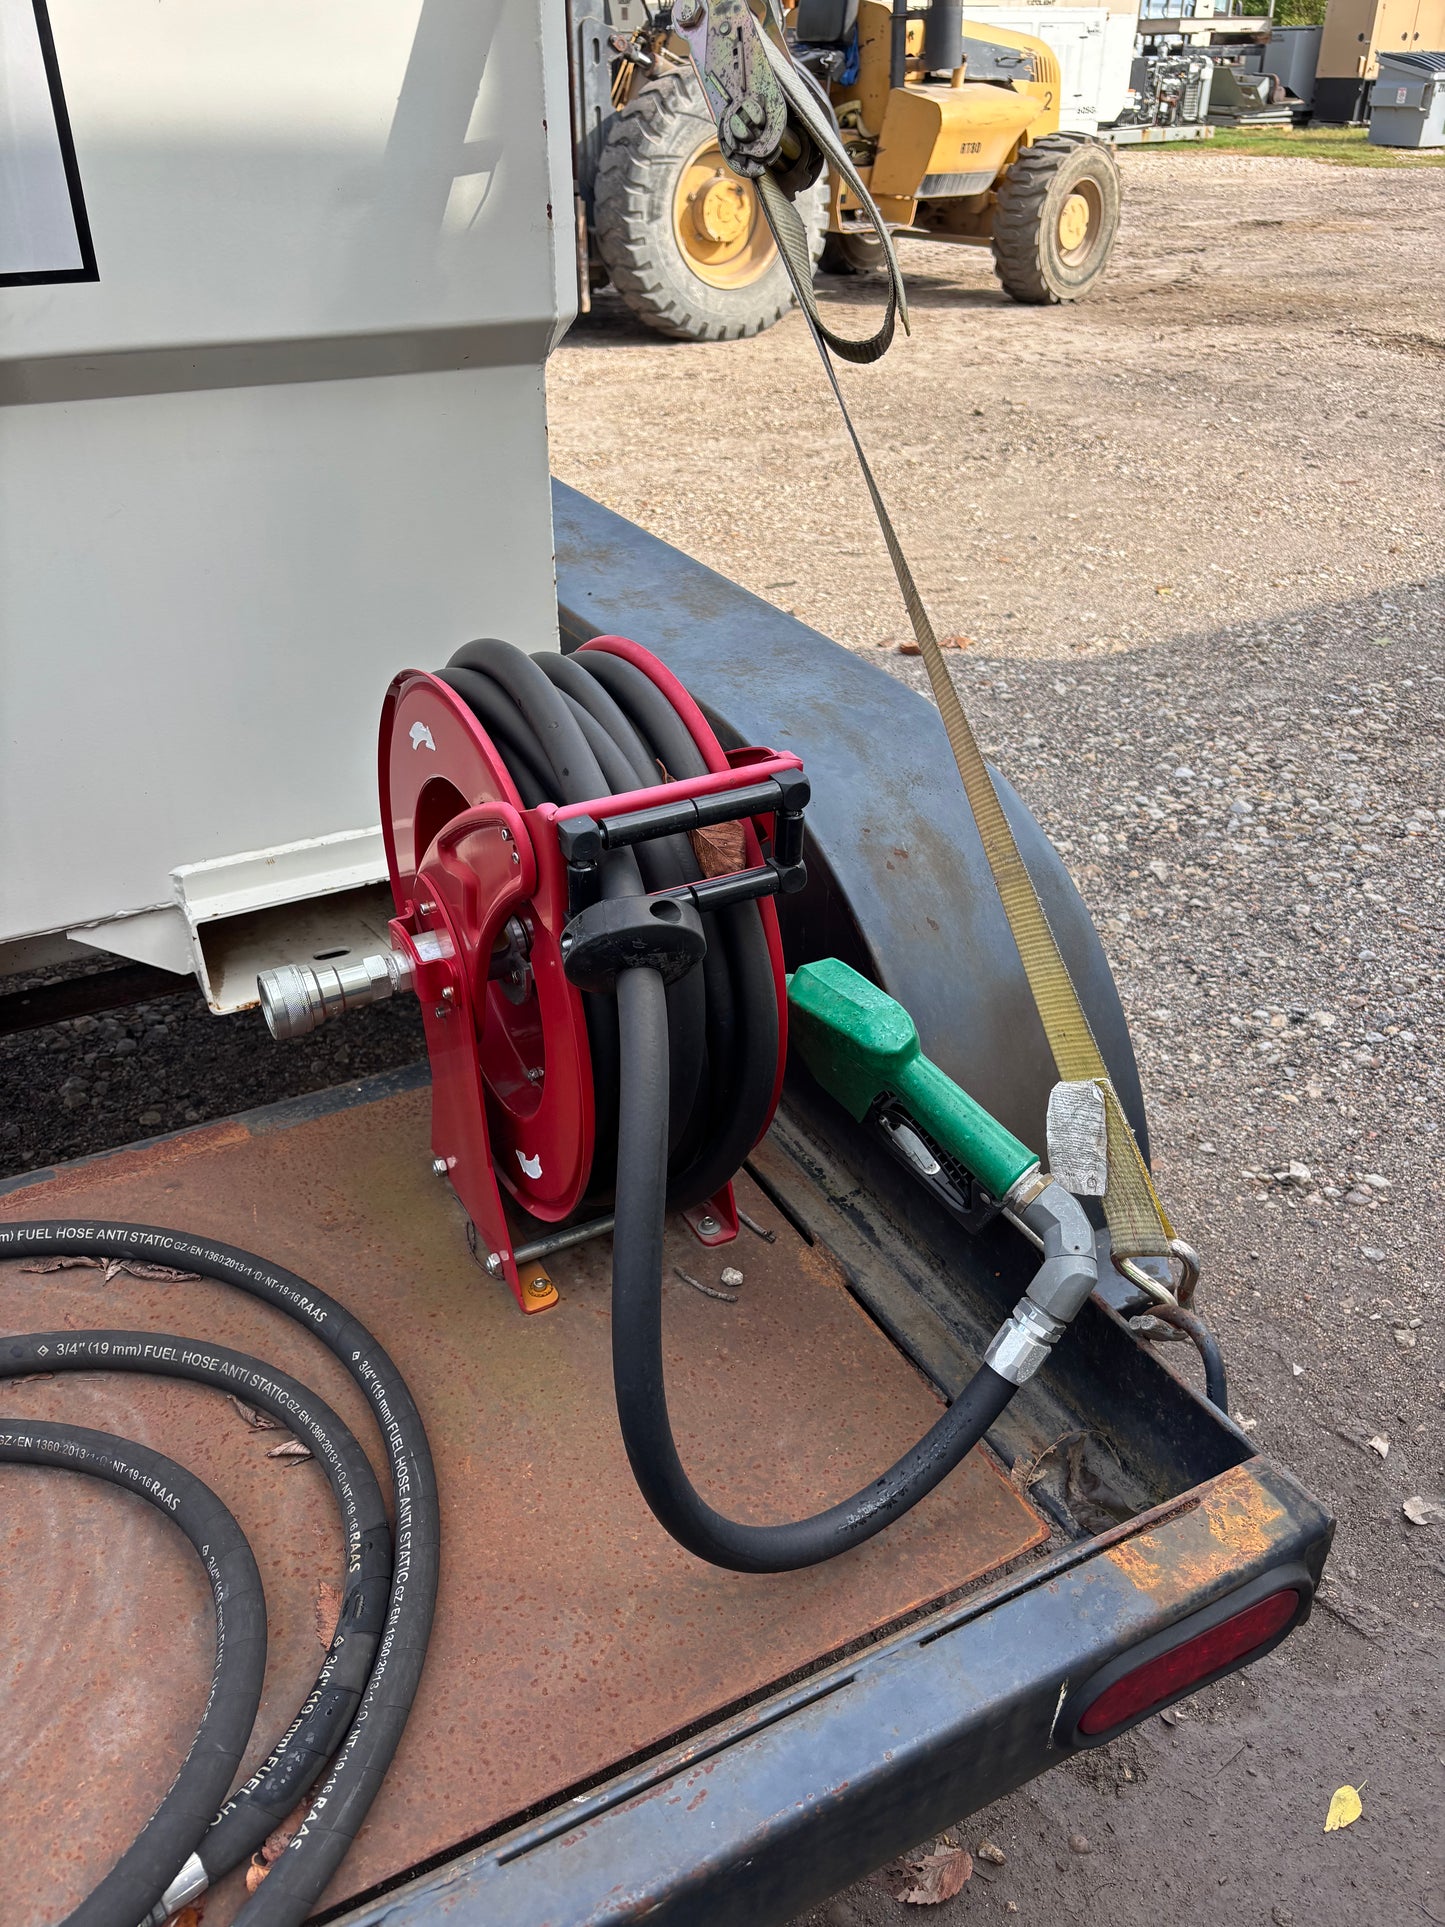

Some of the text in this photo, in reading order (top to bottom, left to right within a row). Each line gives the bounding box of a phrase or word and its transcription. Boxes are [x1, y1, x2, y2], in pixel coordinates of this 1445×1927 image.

[1043, 91, 1053, 111] 2
[17, 1227, 52, 1241] FUEL
[55, 1226, 95, 1239] HOSE
[95, 1228, 129, 1242] ANTI
[129, 1231, 174, 1249] STATIC
[297, 1296, 328, 1323] RAAS
[358, 1360, 377, 1380] 3/4"
[370, 1380, 386, 1400] (19
[378, 1398, 395, 1425] mm)
[56, 1342, 85, 1356] 3/4"
[88, 1341, 109, 1355] (19
[112, 1343, 142, 1357] mm)
[144, 1345, 178, 1362] FUEL
[181, 1350, 220, 1371] HOSE
[219, 1361, 251, 1383] ANTI
[249, 1374, 290, 1404] STATIC
[349, 1530, 362, 1574] RAAS
[386, 1422, 404, 1458] FUEL
[395, 1455, 411, 1496] HOSE
[150, 1480, 181, 1512] RAAS
[399, 1497, 412, 1531] ANTI
[396, 1531, 412, 1584] STATIC
[319, 1655, 338, 1687] 3/4"
[301, 1689, 323, 1715] (19
[276, 1718, 303, 1754] mm)
[235, 1756, 278, 1797] FUEL
[290, 1797, 328, 1850] RAAS
